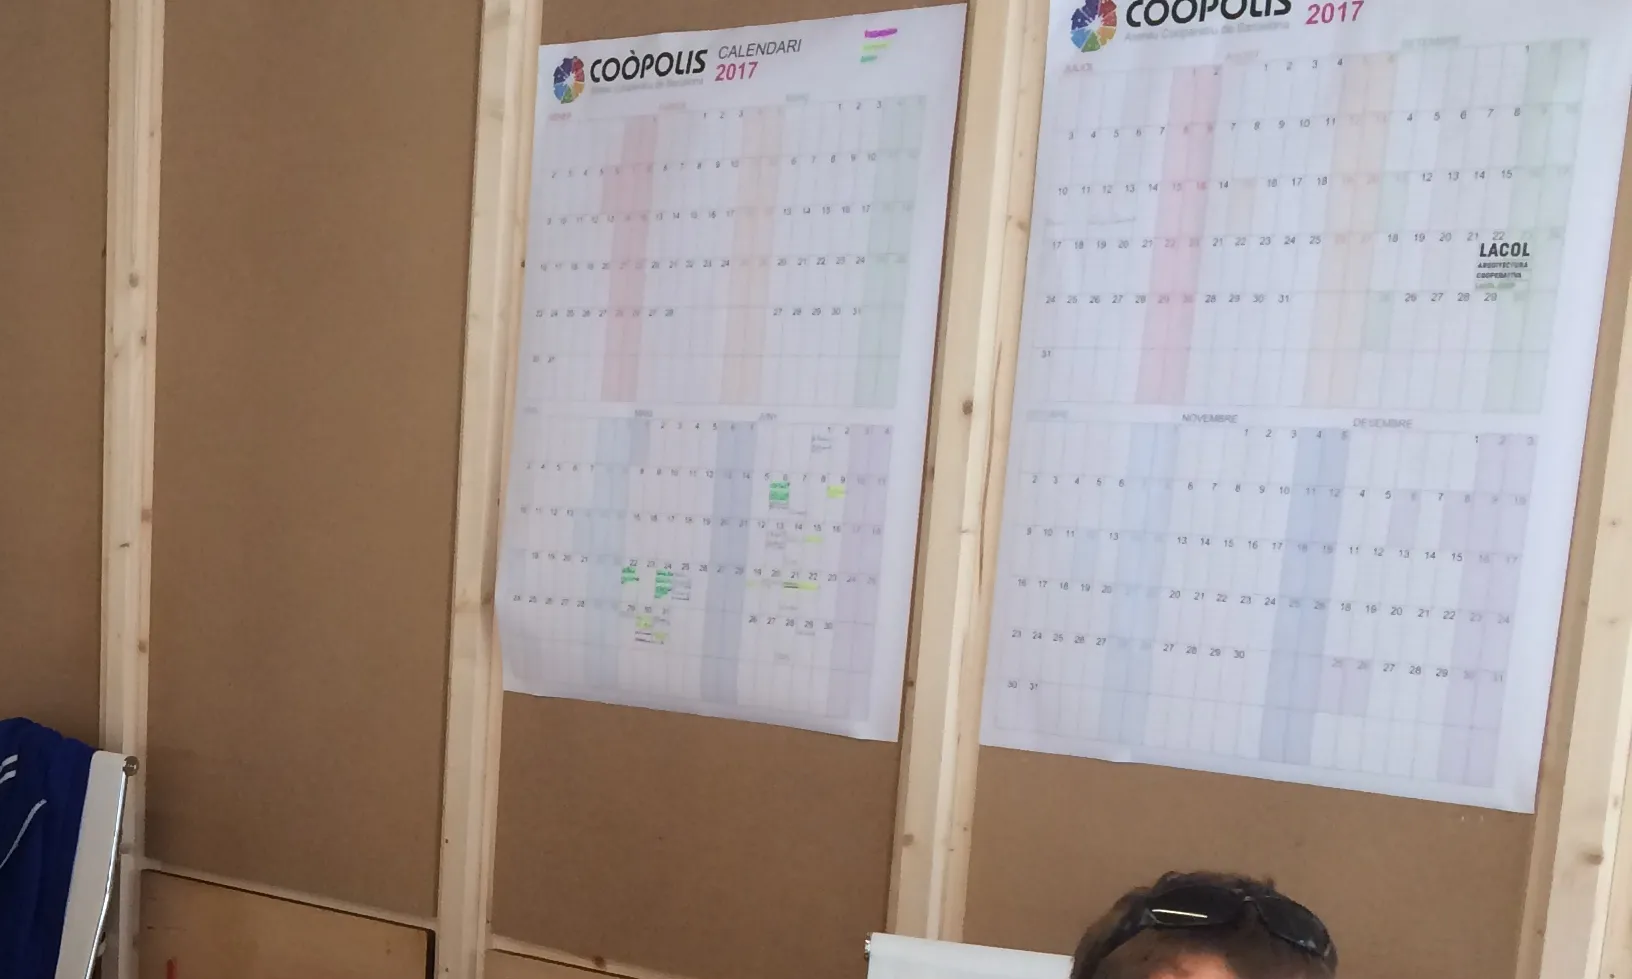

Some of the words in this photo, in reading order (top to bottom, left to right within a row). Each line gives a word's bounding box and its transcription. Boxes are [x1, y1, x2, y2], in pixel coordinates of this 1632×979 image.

[1306, 0, 1364, 25] 2017
[718, 39, 802, 60] CALENDARI
[589, 49, 709, 83] COÒPOLIS
[715, 61, 759, 82] 2017
[1218, 179, 1230, 190] 14
[1474, 170, 1486, 180] 14
[1283, 235, 1296, 246] 24
[1479, 241, 1531, 258] LACOL
[1204, 294, 1217, 304] 28
[1181, 413, 1239, 424] NOVEMBRE
[1200, 536, 1212, 547] 14
[1424, 550, 1436, 561] 14
[1264, 596, 1276, 607] 24
[1408, 665, 1422, 675] 28
